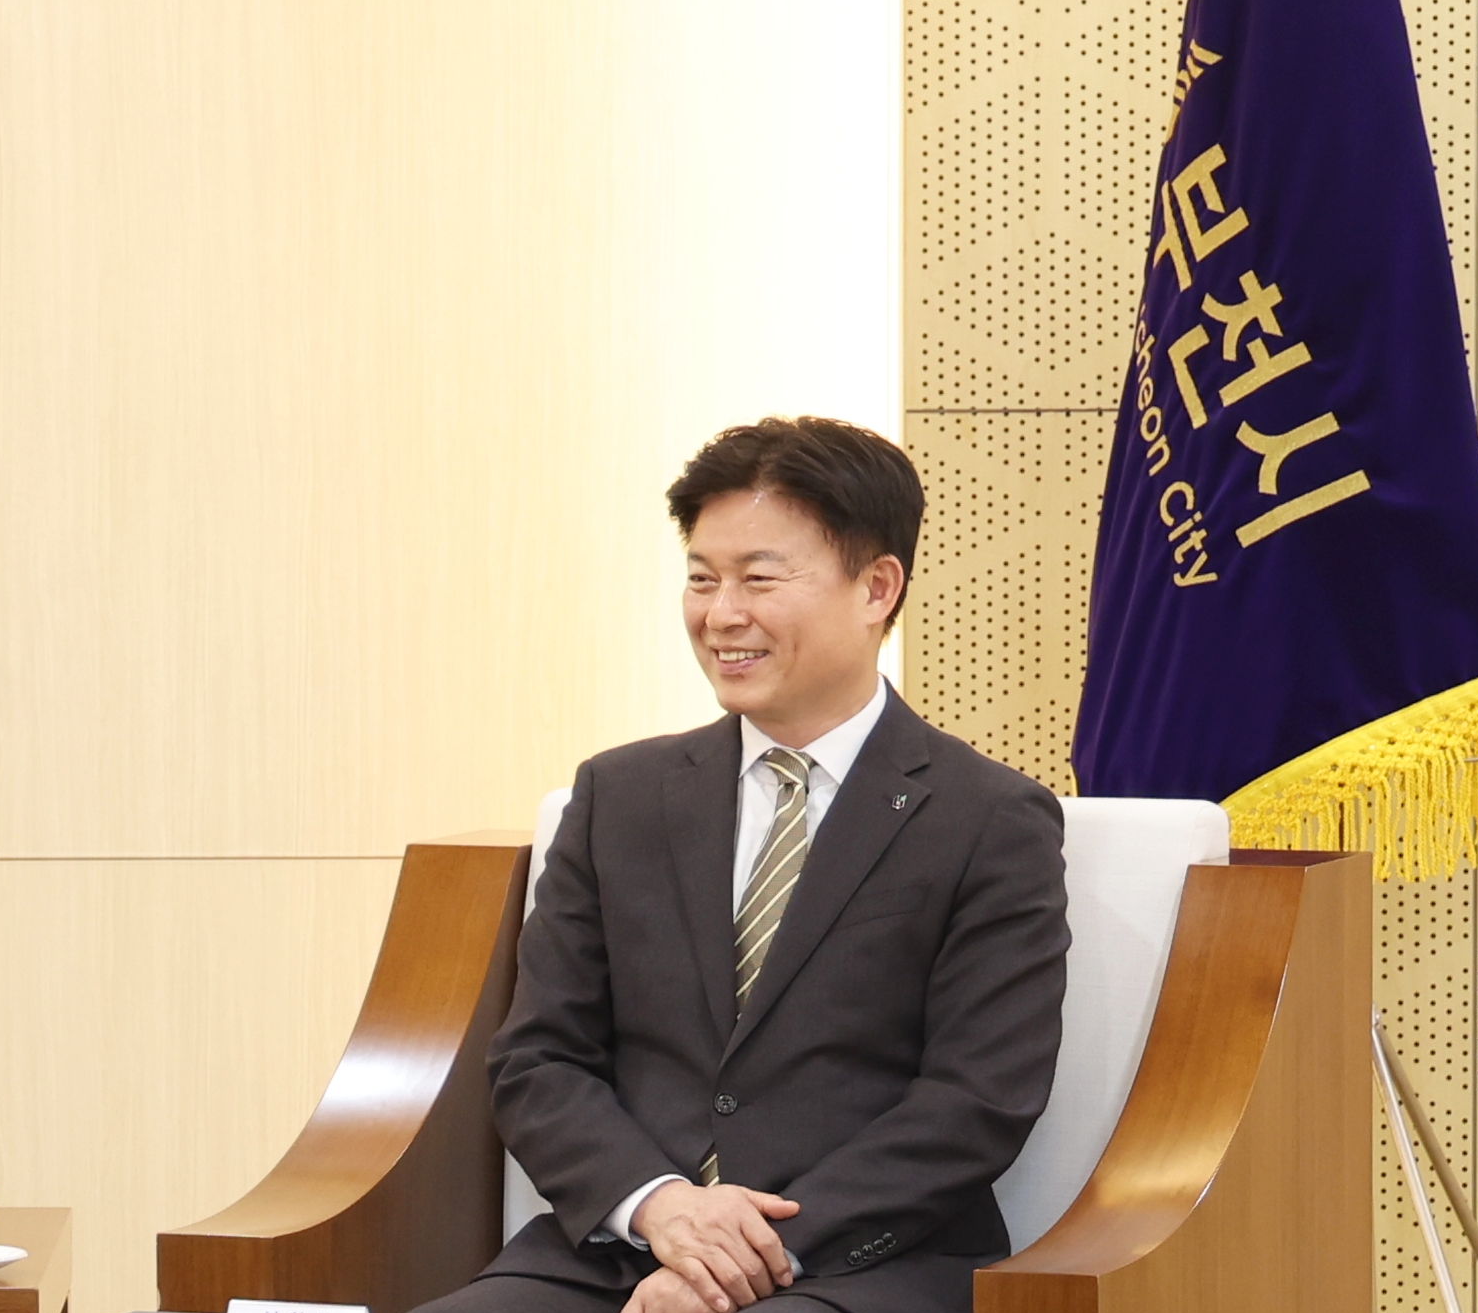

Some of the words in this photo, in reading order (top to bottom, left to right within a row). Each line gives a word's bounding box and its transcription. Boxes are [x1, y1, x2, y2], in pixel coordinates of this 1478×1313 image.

[1135, 303, 1171, 477] cheon
[1159, 481, 1219, 587] City
[1153, 143, 1371, 548] 부천시
